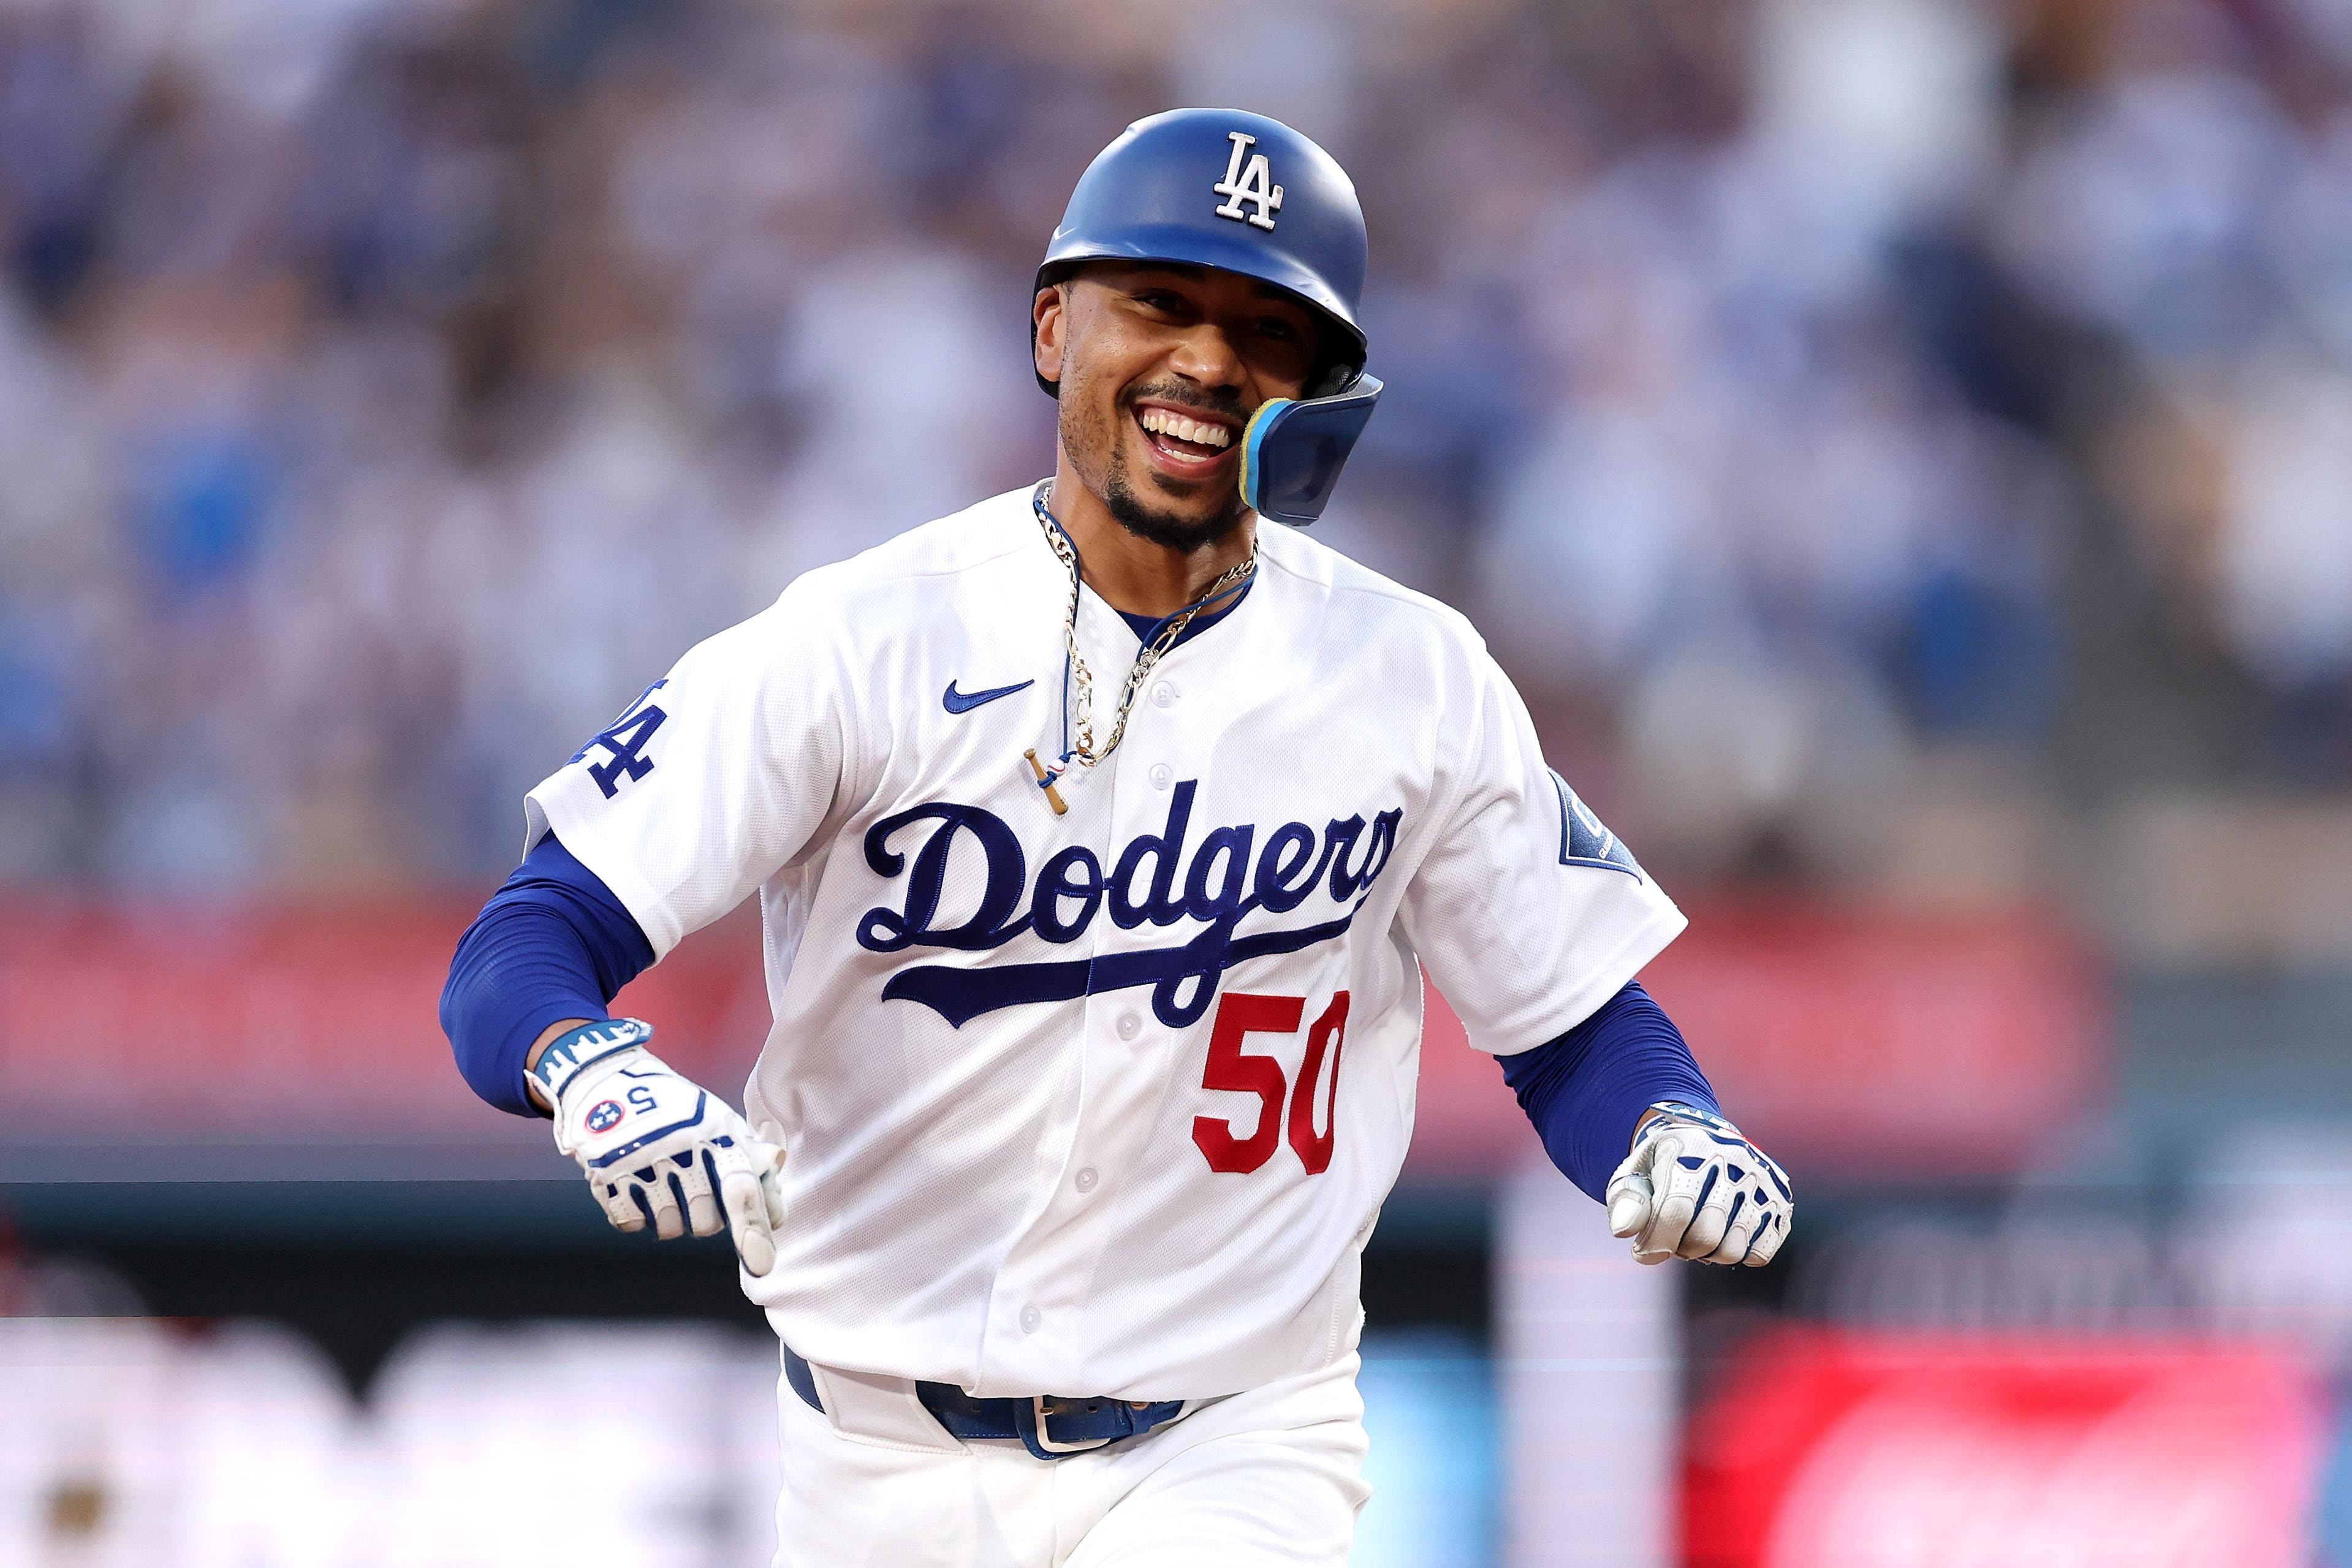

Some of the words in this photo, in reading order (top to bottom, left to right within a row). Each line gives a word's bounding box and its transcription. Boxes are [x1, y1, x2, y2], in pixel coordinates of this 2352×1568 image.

[1213, 131, 1284, 230] LA
[856, 779, 1403, 1029] Dodgers
[627, 1086, 658, 1115] 5
[1193, 990, 1351, 1176] 50
